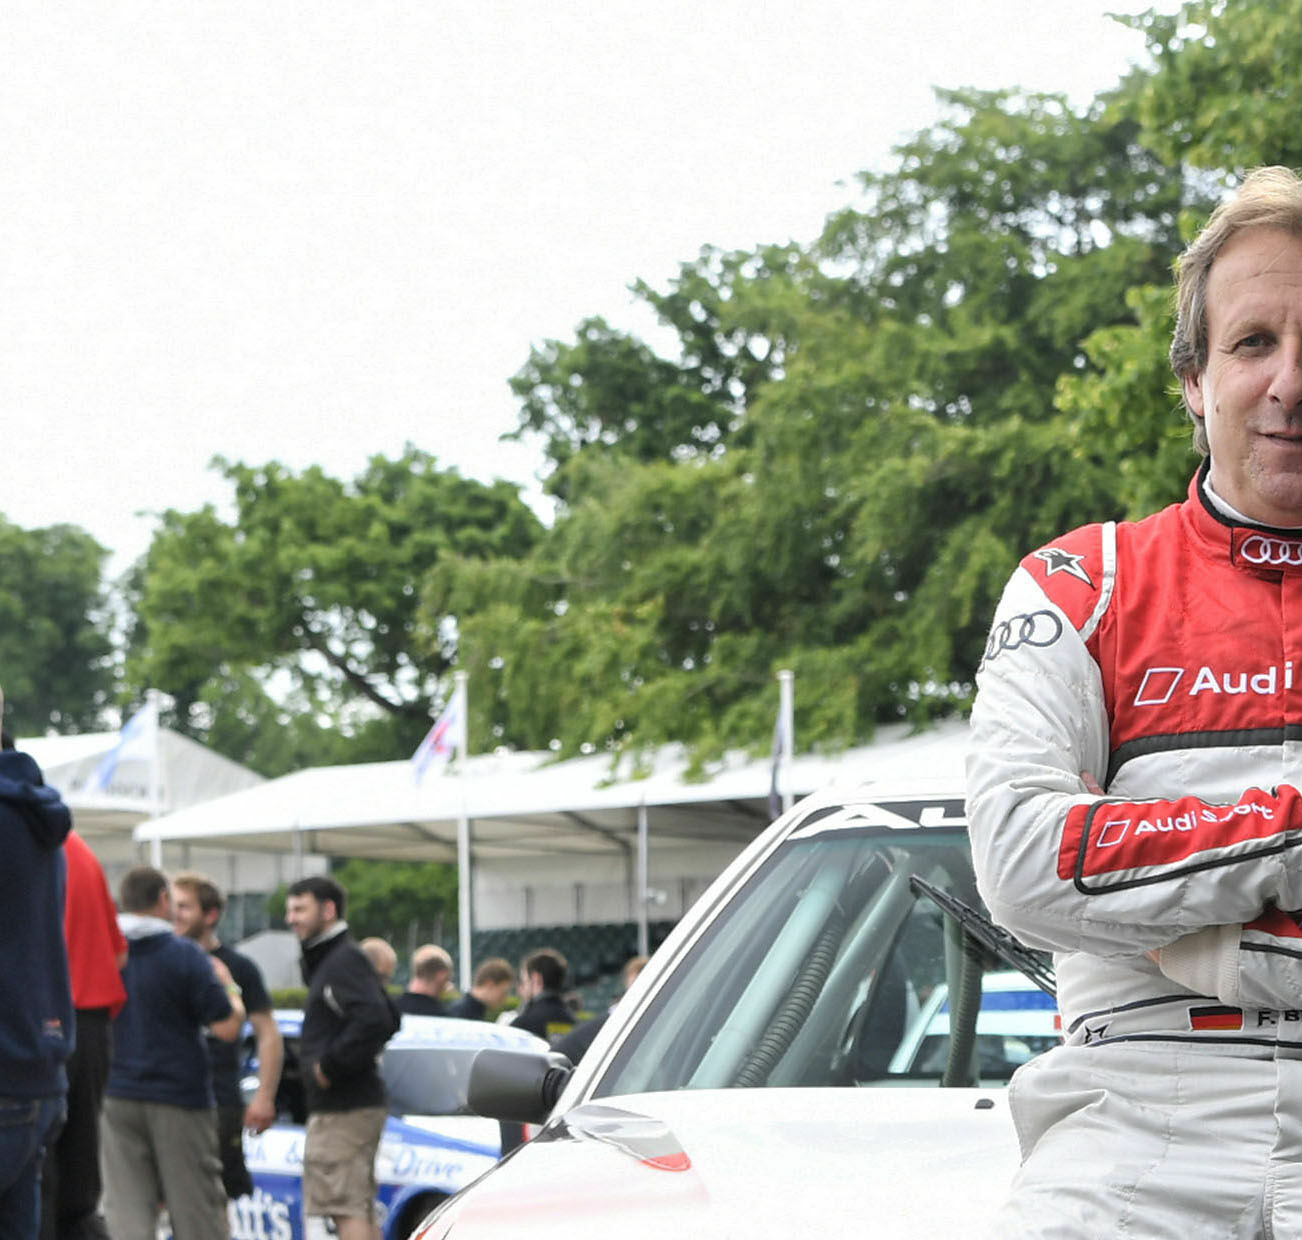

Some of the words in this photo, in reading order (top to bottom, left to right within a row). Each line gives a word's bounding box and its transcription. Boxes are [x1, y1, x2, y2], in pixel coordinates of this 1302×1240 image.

[1189, 661, 1293, 696] Audi
[1134, 811, 1198, 836] Audi
[1257, 1008, 1276, 1026] F.
